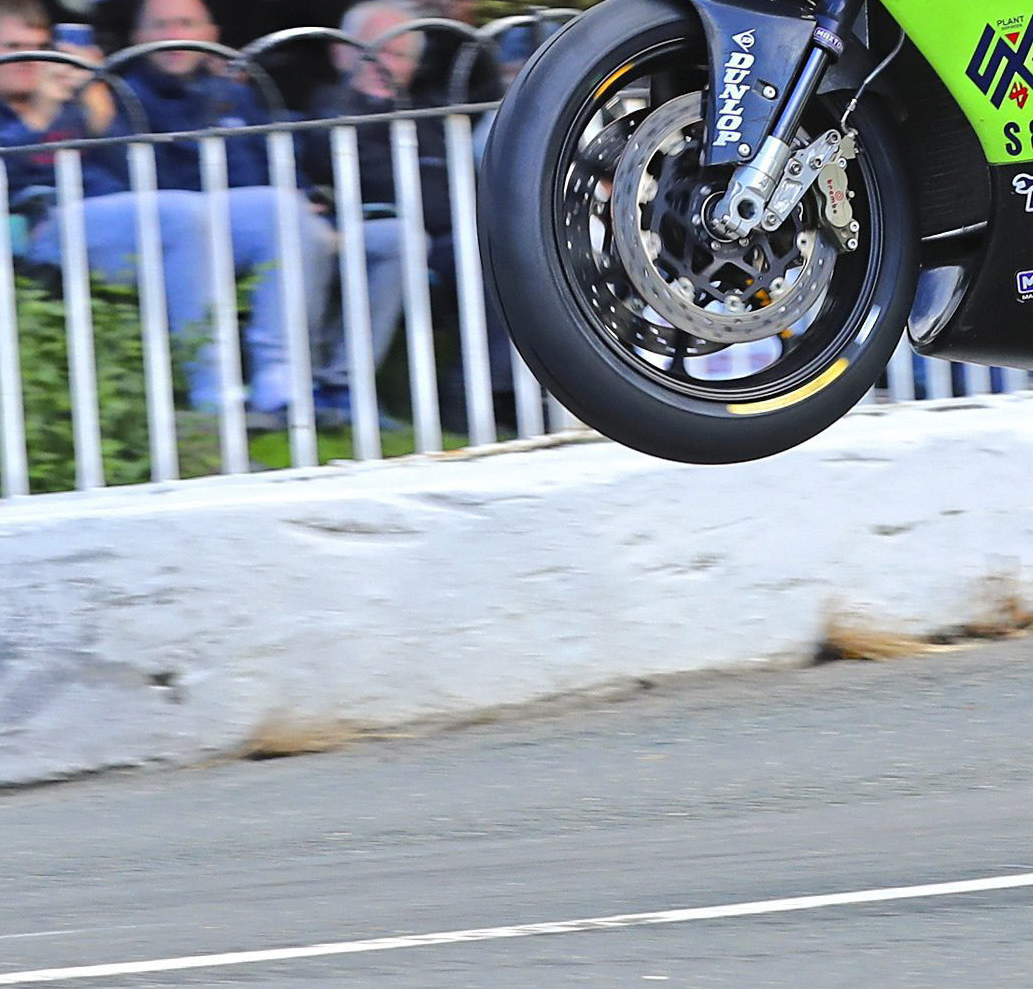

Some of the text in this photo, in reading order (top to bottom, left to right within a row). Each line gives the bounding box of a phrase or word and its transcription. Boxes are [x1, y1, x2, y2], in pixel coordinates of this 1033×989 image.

[997, 15, 1024, 27] PLANT
[712, 52, 755, 146] DUNLOP
[1003, 121, 1022, 156] S
